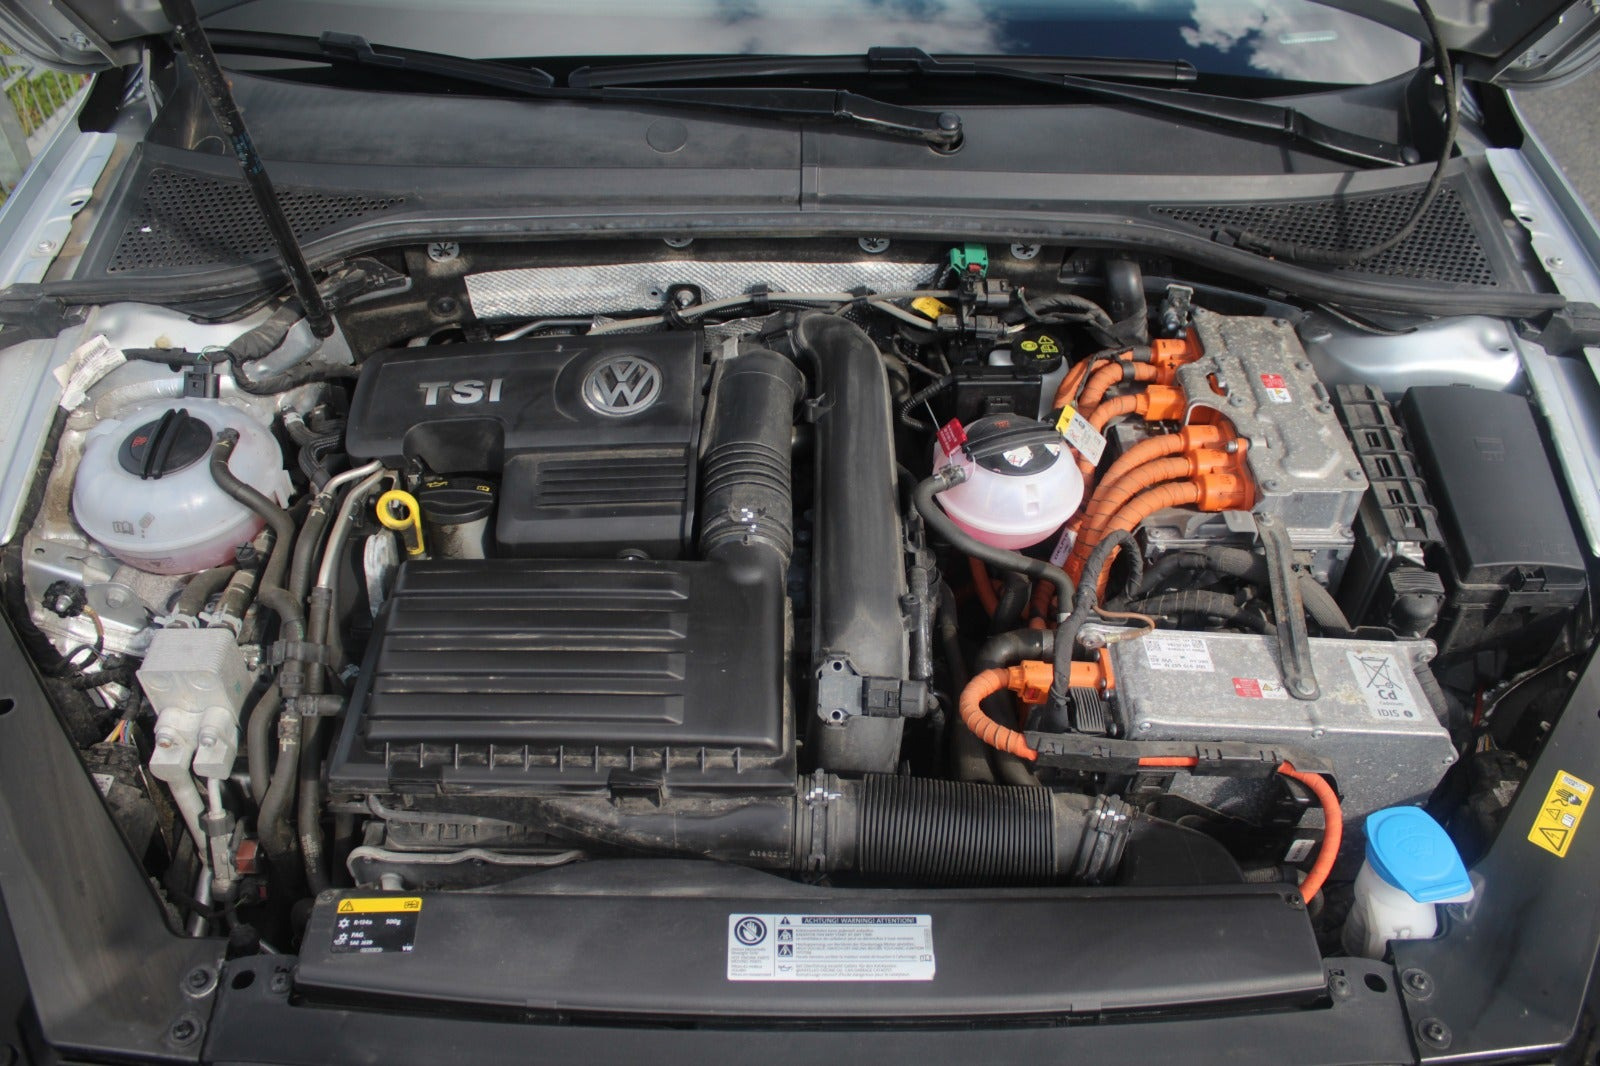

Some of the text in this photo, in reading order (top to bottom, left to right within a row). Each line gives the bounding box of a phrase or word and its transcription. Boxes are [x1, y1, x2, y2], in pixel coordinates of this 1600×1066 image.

[418, 378, 504, 406] TSI
[1378, 689, 1398, 700] Cd
[1377, 708, 1400, 717] IDIS
